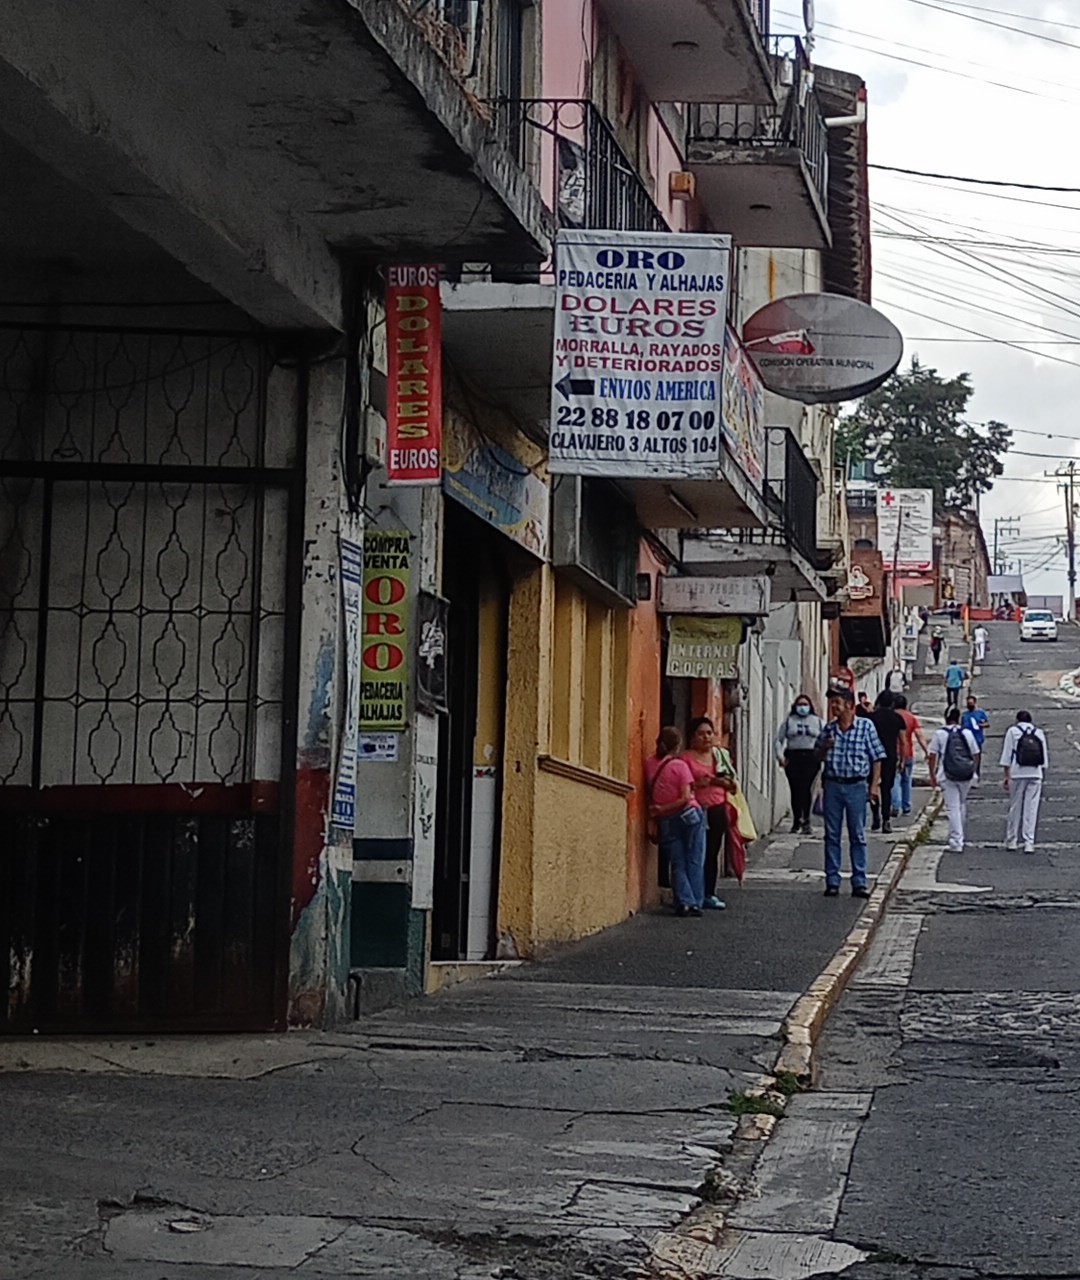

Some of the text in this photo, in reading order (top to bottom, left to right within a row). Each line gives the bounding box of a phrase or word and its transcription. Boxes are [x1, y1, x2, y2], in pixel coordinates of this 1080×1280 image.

[596, 249, 685, 270] ORO
[388, 266, 437, 287] EUROS
[559, 269, 724, 292] PEDACERIA Y ALHAJAS
[561, 294, 717, 316] DOLARES
[570, 314, 706, 338] EUROS
[556, 338, 721, 358] MORRALLA, RAYADOS
[396, 295, 430, 439] DOLARES
[556, 355, 721, 372] Y DETERIORADOS
[600, 378, 716, 401] ENVIOS AMERICA
[557, 406, 715, 431] 22 88 18 07 00
[551, 432, 717, 454] CLAVIJERO 3 ALTOS 104
[390, 448, 438, 470] EUROS
[363, 537, 410, 554] COMPRA
[363, 555, 409, 569] VENTA
[362, 575, 406, 672] ORO
[672, 644, 736, 657] INTERNET
[671, 661, 737, 675] COPIAS
[360, 704, 403, 721] ALHAJAS
